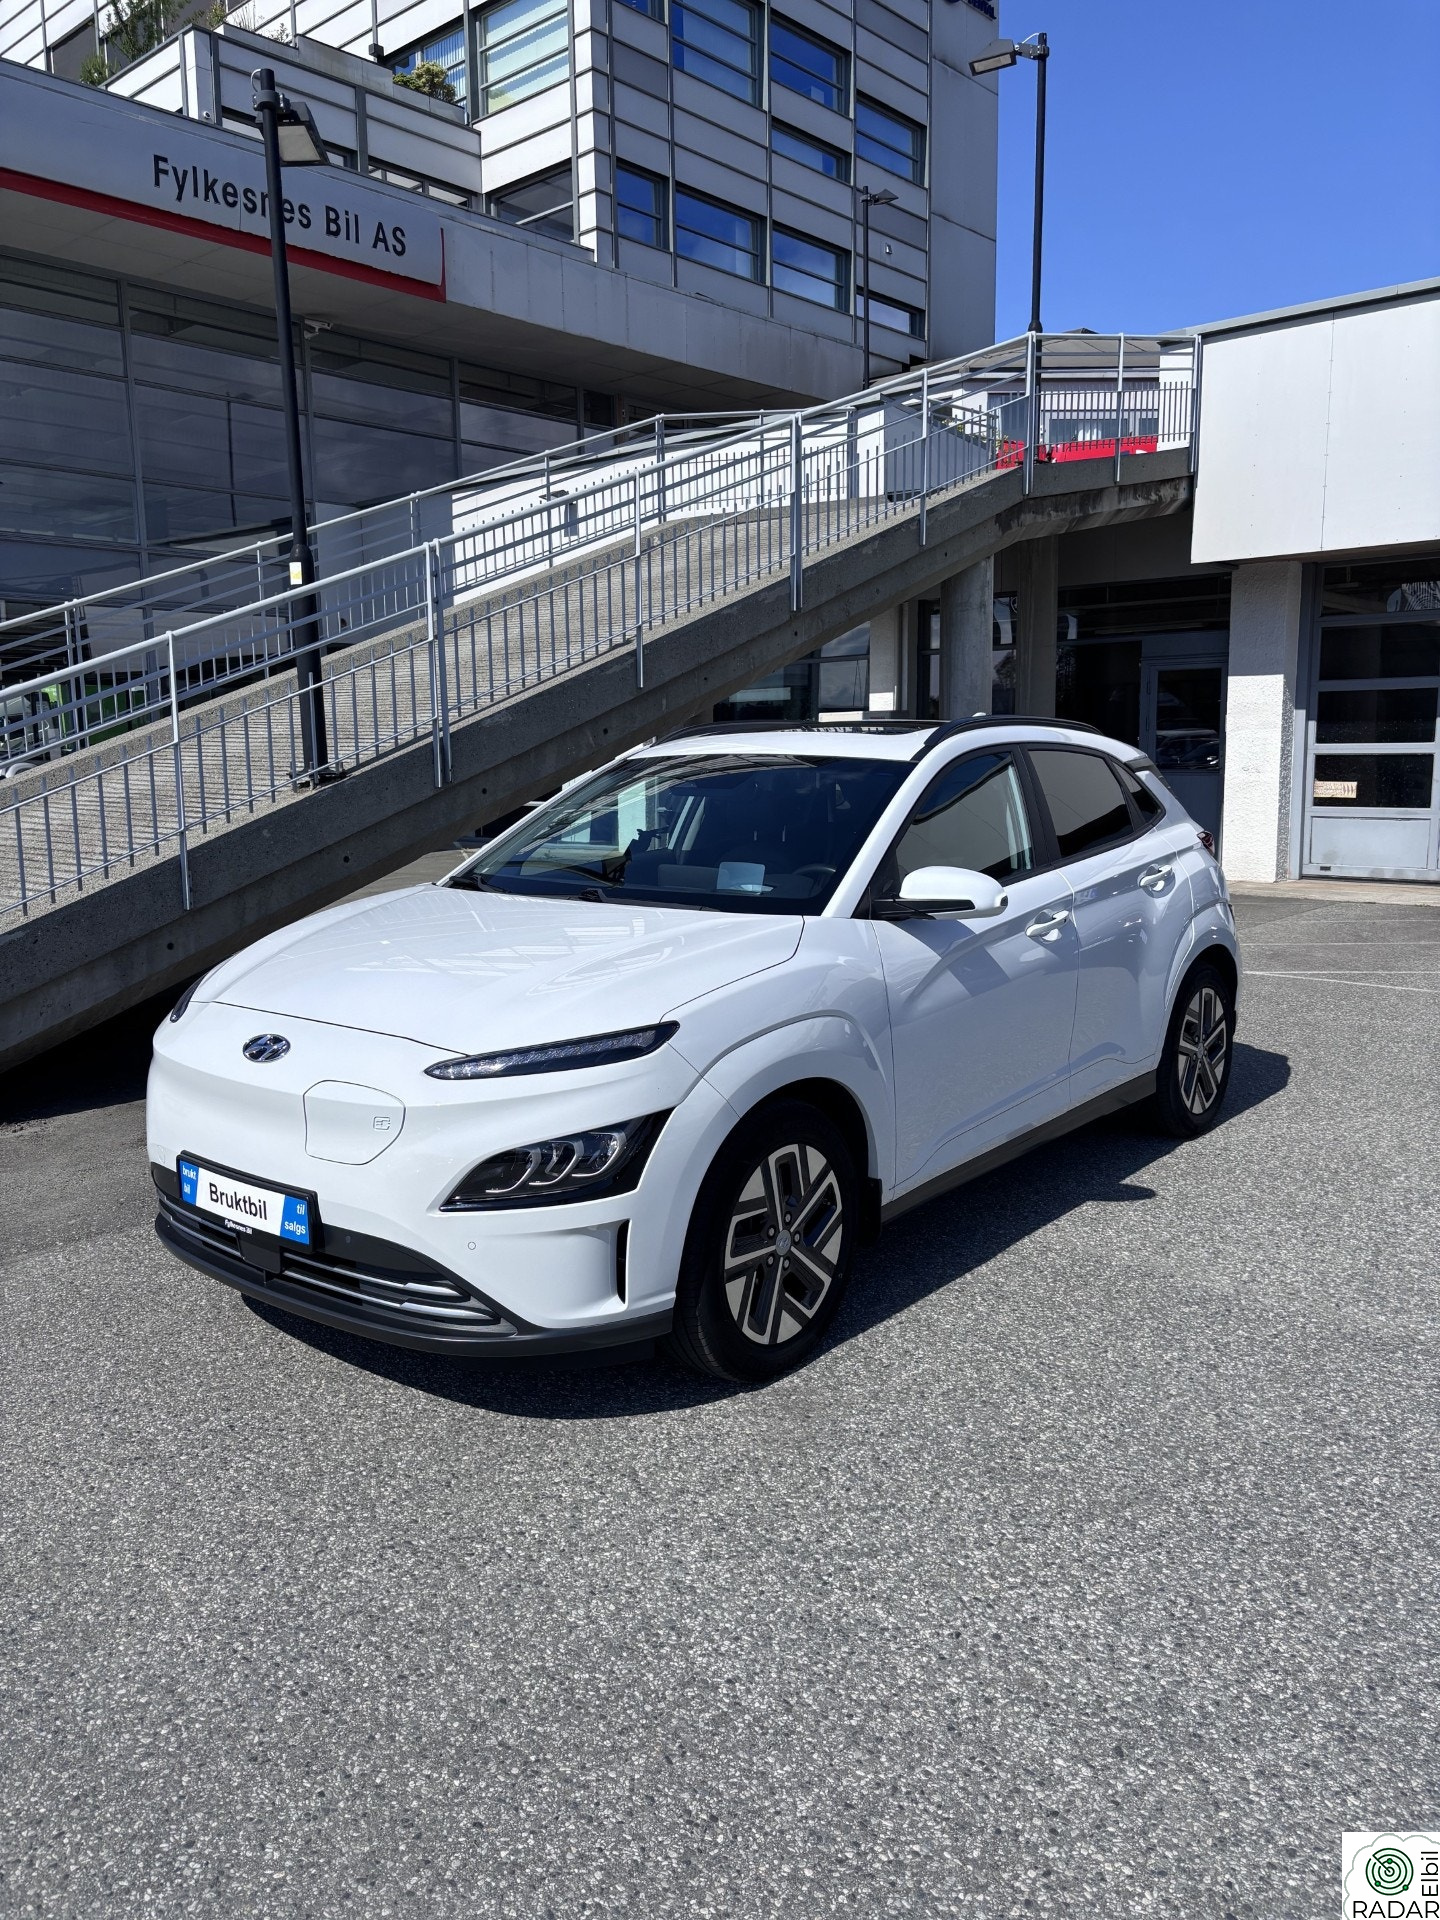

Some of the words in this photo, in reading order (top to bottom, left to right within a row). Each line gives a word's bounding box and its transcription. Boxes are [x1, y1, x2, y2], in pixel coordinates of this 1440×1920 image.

[325, 205, 360, 244] Bil
[372, 221, 407, 257] AS
[182, 1164, 197, 1180] brukt
[183, 1182, 191, 1195] bil
[209, 1182, 268, 1221] Bruktbil
[296, 1203, 305, 1215] til
[284, 1221, 307, 1235] salgs
